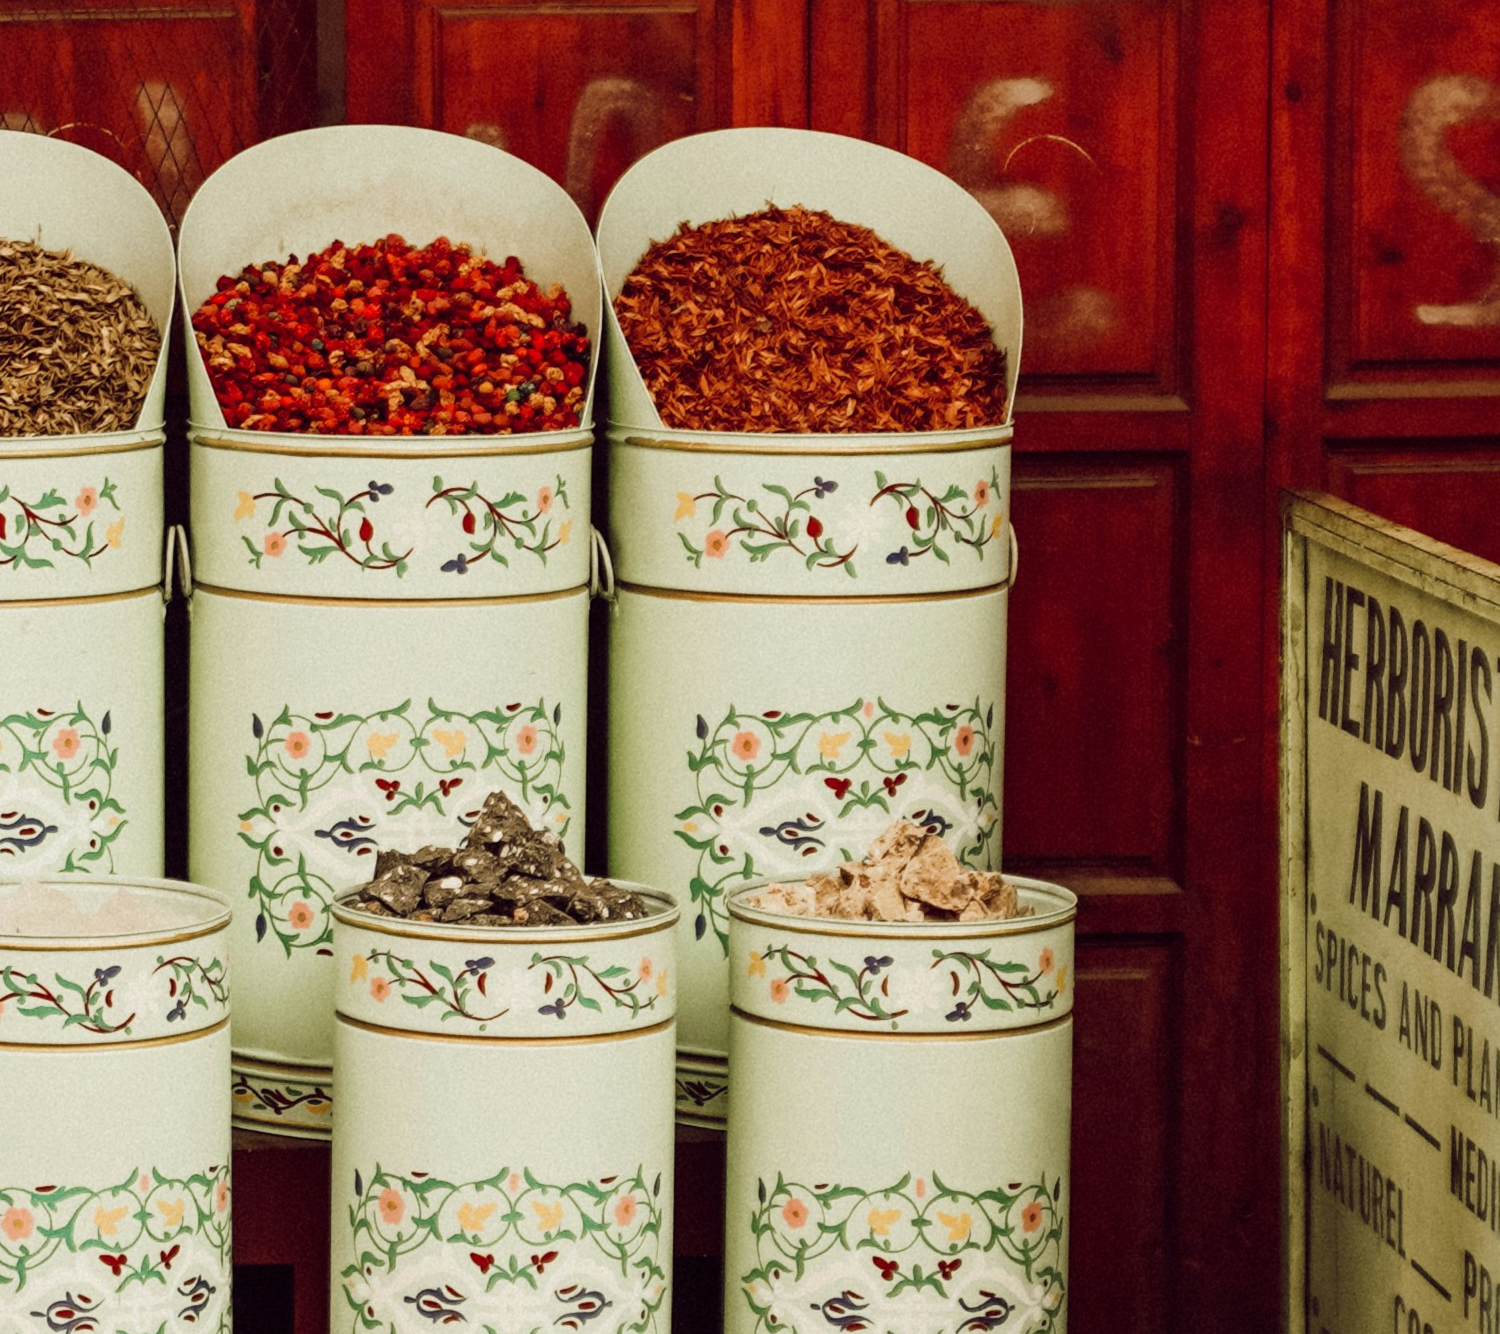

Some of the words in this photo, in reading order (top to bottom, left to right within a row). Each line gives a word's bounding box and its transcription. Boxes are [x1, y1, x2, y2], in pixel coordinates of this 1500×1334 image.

[1315, 919, 1388, 1031] SPICES
[1399, 980, 1443, 1072] AND
[1319, 1120, 1407, 1260] NATUREL
